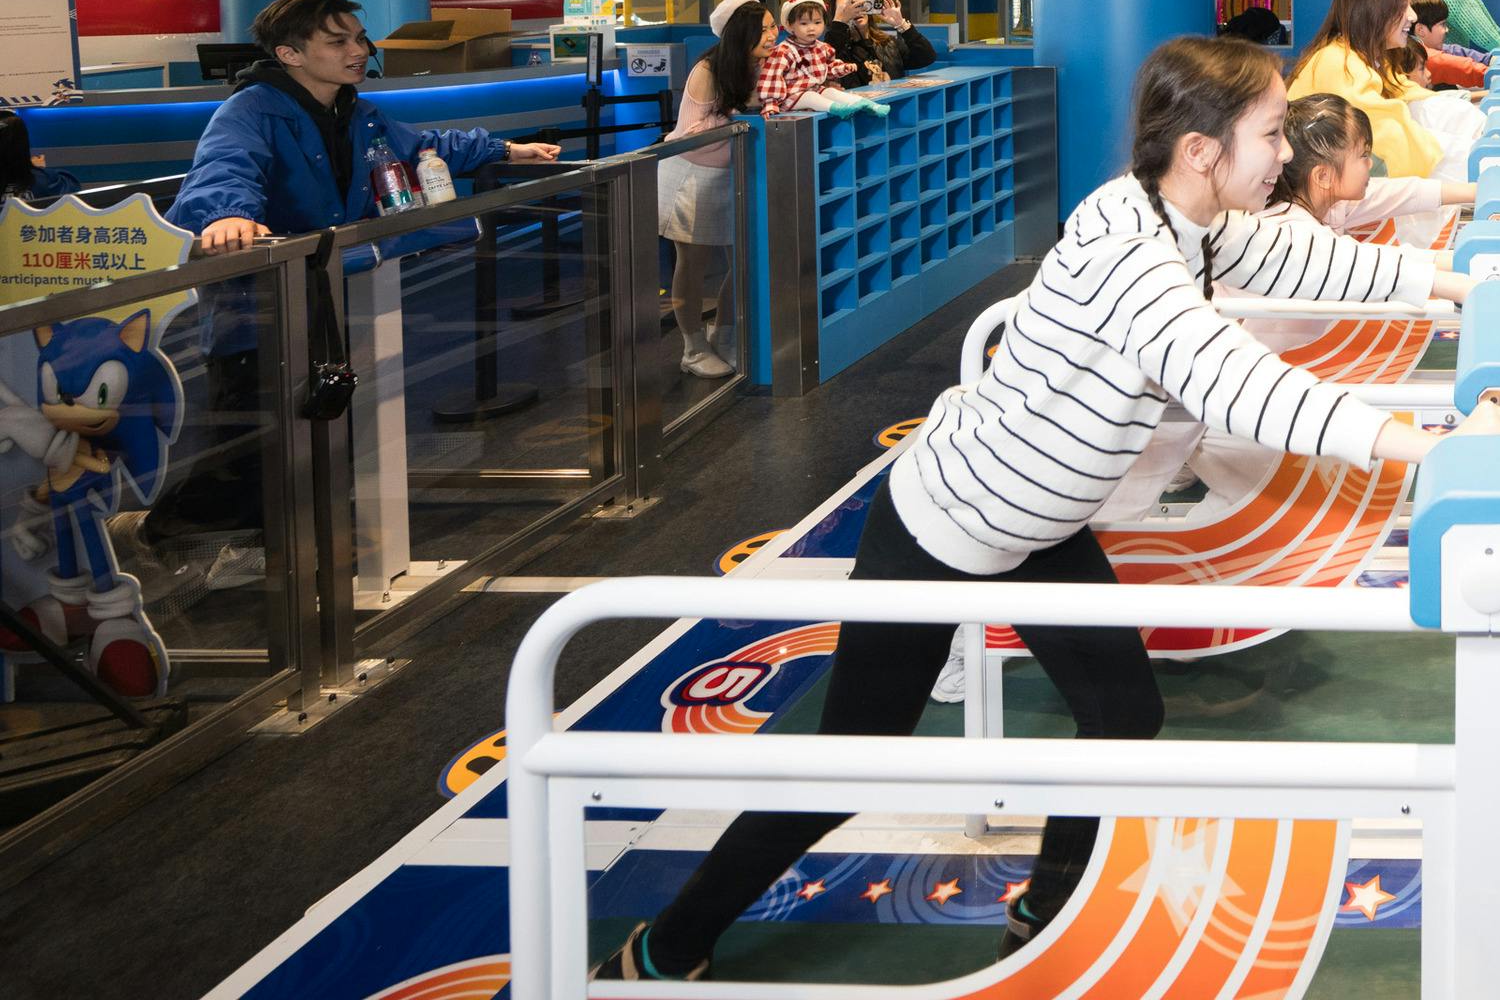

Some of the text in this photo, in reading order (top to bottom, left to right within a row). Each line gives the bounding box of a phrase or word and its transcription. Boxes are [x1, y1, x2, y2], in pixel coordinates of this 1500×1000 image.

[19, 225, 148, 245] 參加者身高須為
[22, 252, 147, 271] 110厘米或以上
[687, 666, 763, 700] 5
